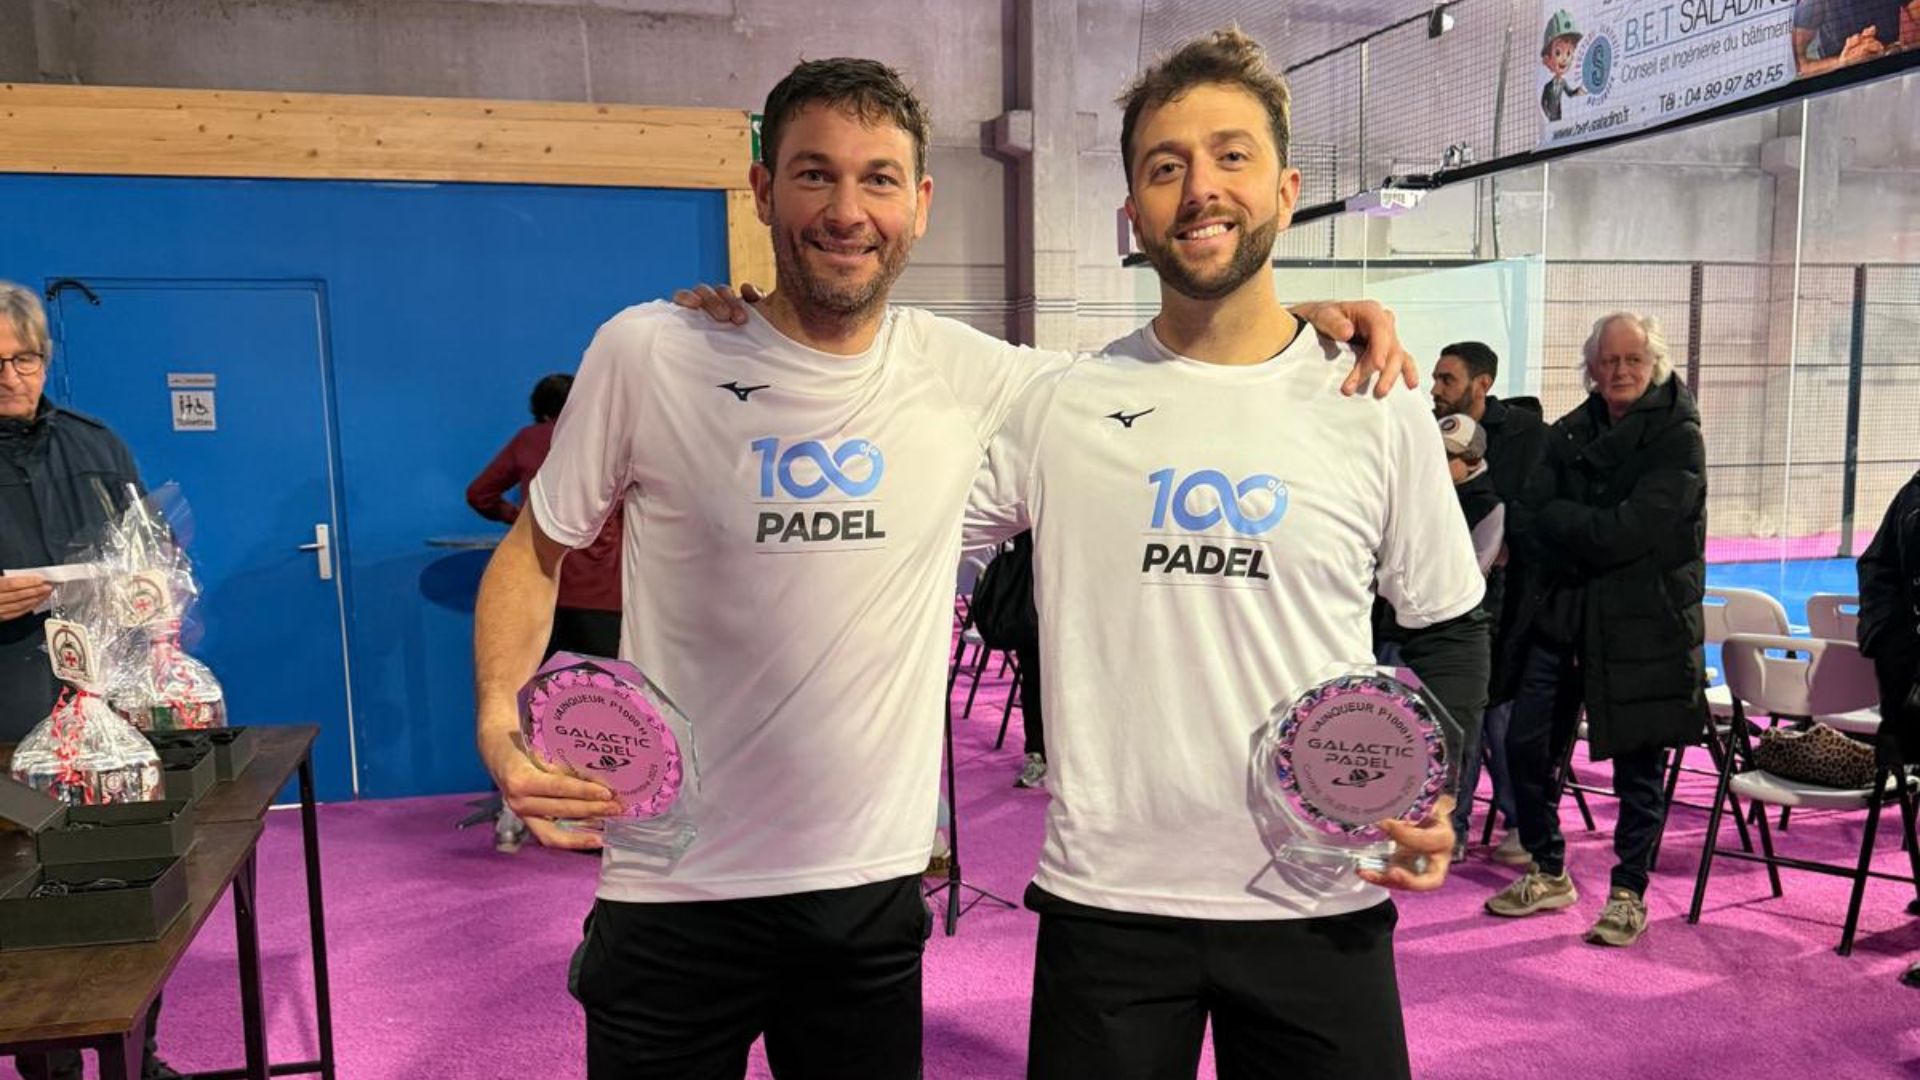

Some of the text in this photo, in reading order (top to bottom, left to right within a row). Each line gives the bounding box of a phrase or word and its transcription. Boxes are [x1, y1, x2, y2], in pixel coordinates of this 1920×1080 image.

[1679, 0, 1791, 33] SALA
[1621, 57, 1660, 83] Conseil
[1659, 53, 1671, 73] et
[1723, 32, 1738, 53] du
[1742, 16, 1793, 47] bâtiment
[1685, 86, 1701, 107] 04
[1703, 80, 1722, 101] 89
[1724, 74, 1743, 96] 97
[1743, 69, 1762, 91] 83
[1764, 63, 1784, 84] 55
[755, 509, 886, 543] PADEL
[1142, 543, 1270, 580] PADEL
[554, 694, 606, 722] VAINQUEUR
[609, 701, 640, 727] P1000
[1309, 702, 1375, 733] VAINQUEUR
[1378, 706, 1409, 736] P1000
[554, 725, 651, 748] GALACTIC
[574, 740, 637, 758] PADEL
[1307, 738, 1415, 758] GALACTIC
[1324, 753, 1393, 769] PADEL
